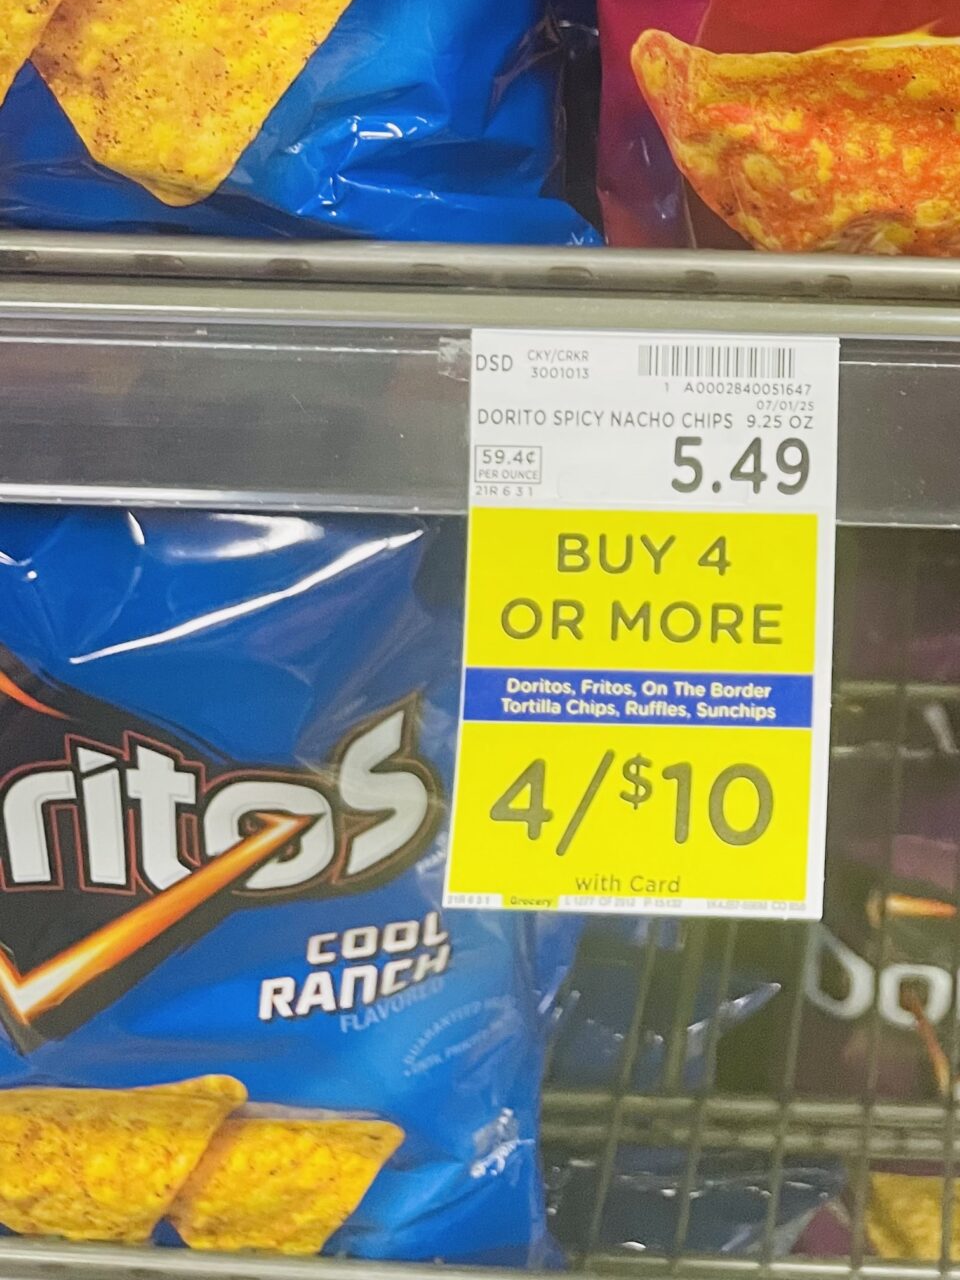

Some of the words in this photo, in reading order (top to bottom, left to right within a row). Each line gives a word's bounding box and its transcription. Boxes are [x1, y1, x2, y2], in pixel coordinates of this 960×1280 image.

[476, 354, 513, 372] DSD
[527, 349, 590, 363] CKY/CRKR
[530, 366, 590, 380] 3001013
[684, 381, 812, 396] A0002840051647
[756, 400, 815, 412] 07/01/25
[477, 408, 547, 426] DORITO
[553, 410, 604, 428] SPICY
[610, 411, 675, 428] NACHO
[681, 412, 733, 430] CHIPS
[745, 414, 782, 430] 9.25
[789, 415, 815, 430] OZ
[482, 449, 536, 466] 59.4¢
[671, 436, 810, 495] 5.49
[478, 469, 499, 480] PER
[502, 469, 540, 481] OUNCE
[556, 532, 677, 575] BUY
[697, 535, 732, 576] 4
[500, 597, 585, 640] OR
[611, 600, 784, 645] MORE
[506, 678, 575, 696] Doritos,
[581, 679, 636, 697] Fritos,
[641, 681, 668, 697] On
[673, 681, 706, 697] The
[710, 682, 772, 699] Border
[501, 697, 562, 715] Tortilla
[566, 698, 620, 718] Chips,
[625, 700, 691, 719] Ruffles,
[696, 702, 776, 720] Sunchips
[489, 749, 774, 857] 4/$10
[575, 874, 621, 892] with
[630, 876, 681, 893] Card
[510, 895, 553, 907] Grocery
[307, 913, 449, 964] COOL
[259, 946, 450, 1020] RANCH
